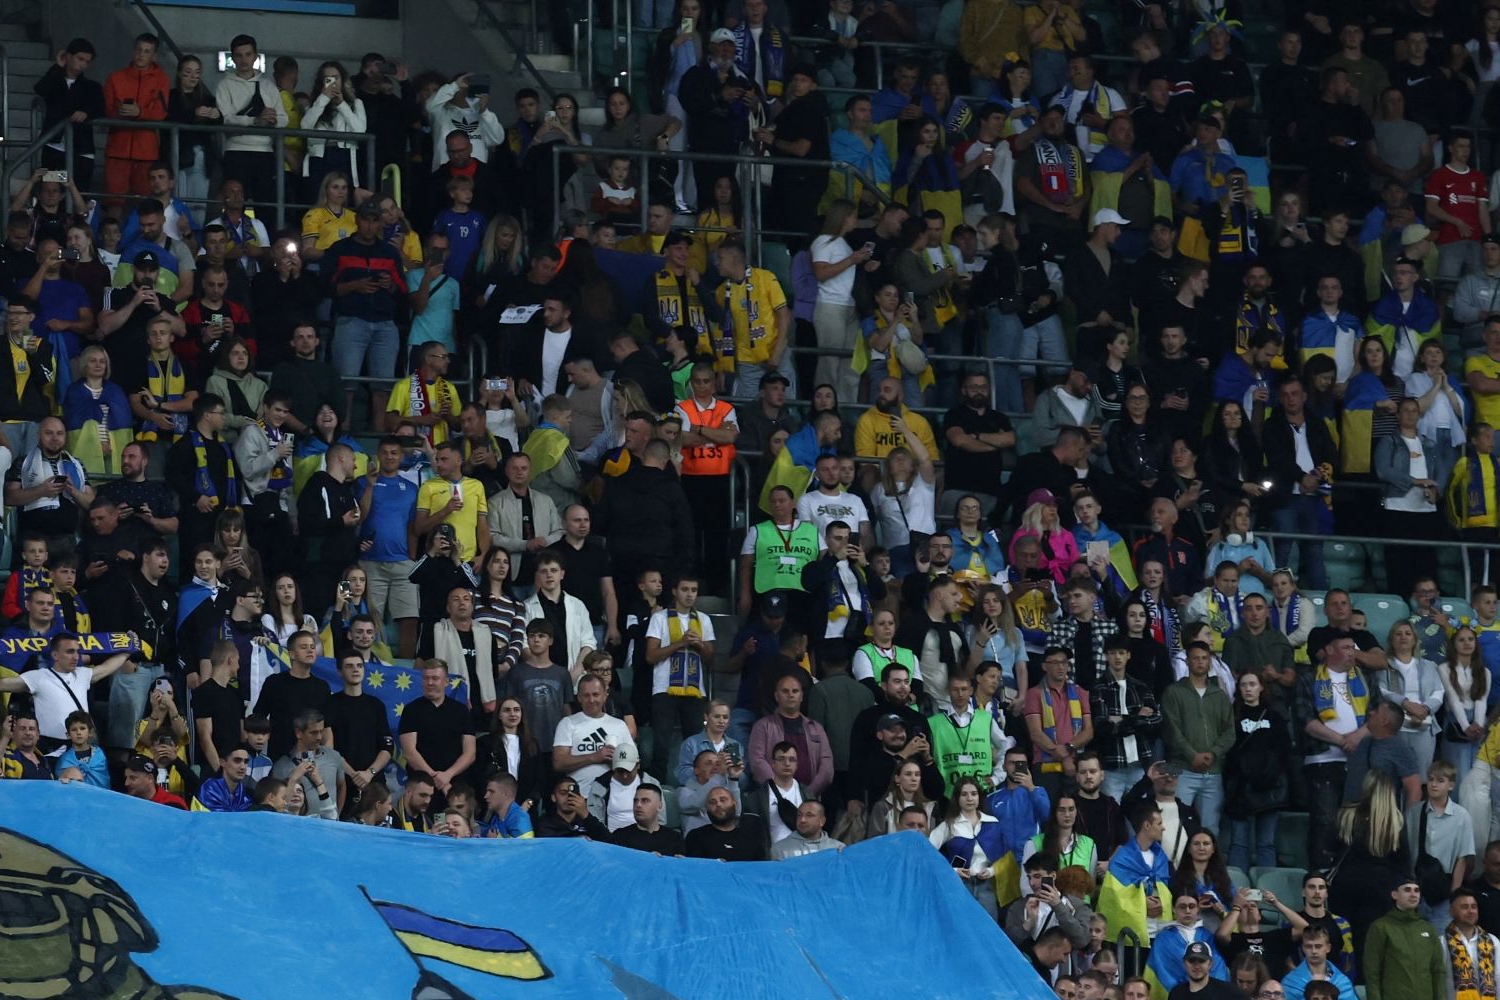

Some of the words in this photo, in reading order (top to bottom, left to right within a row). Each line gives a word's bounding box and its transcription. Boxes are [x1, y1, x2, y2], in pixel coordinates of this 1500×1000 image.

[459, 225, 469, 238] 19
[0, 636, 102, 656] УКРНА
[577, 740, 607, 752] adid
